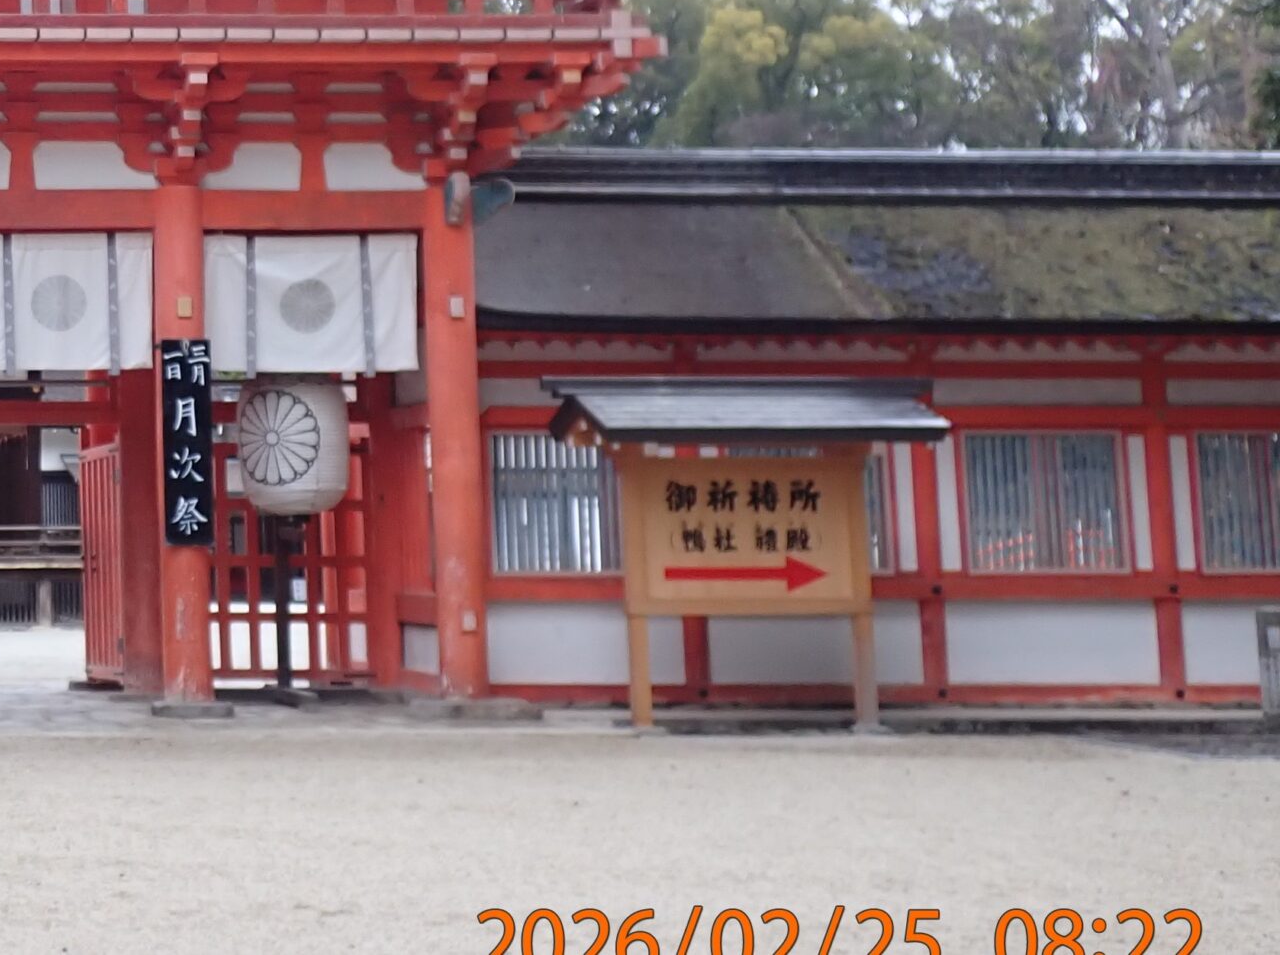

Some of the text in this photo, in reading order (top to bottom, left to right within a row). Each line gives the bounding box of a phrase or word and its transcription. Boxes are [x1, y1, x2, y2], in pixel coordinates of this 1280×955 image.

[163, 350, 184, 380] 一日
[187, 345, 211, 387] 三月
[169, 396, 209, 536] 月次祭
